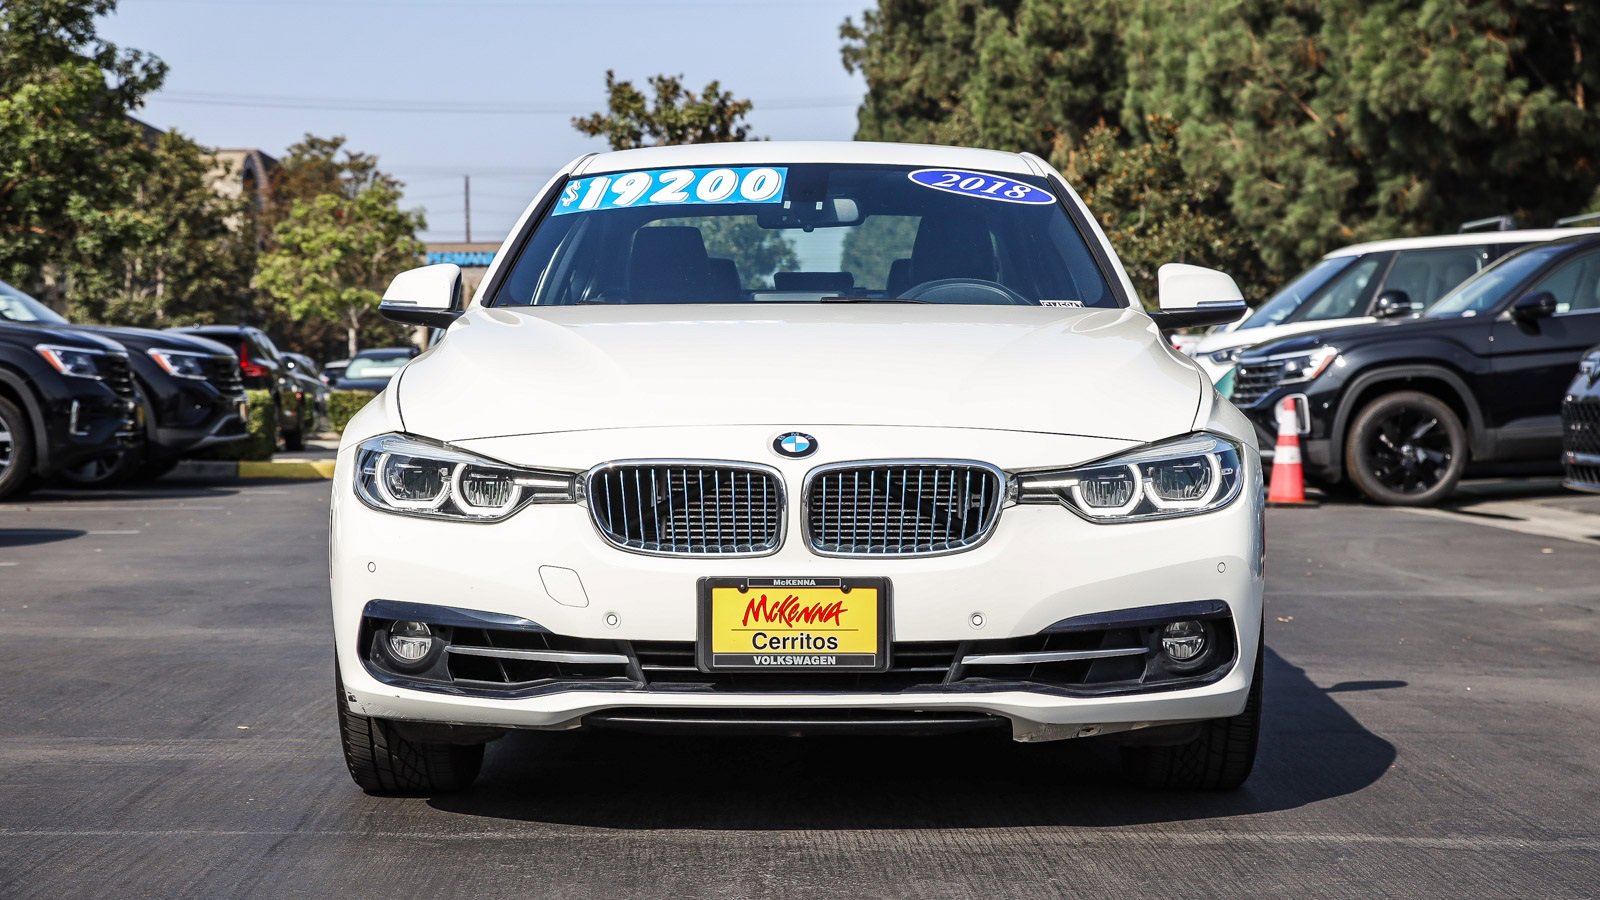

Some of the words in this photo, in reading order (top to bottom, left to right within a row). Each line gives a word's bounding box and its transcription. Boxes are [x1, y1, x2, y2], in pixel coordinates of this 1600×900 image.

[562, 168, 783, 211] $19200
[932, 173, 1032, 199] 2018
[752, 632, 838, 650] Cerritos
[753, 655, 836, 665] VOLKSWAGEN
